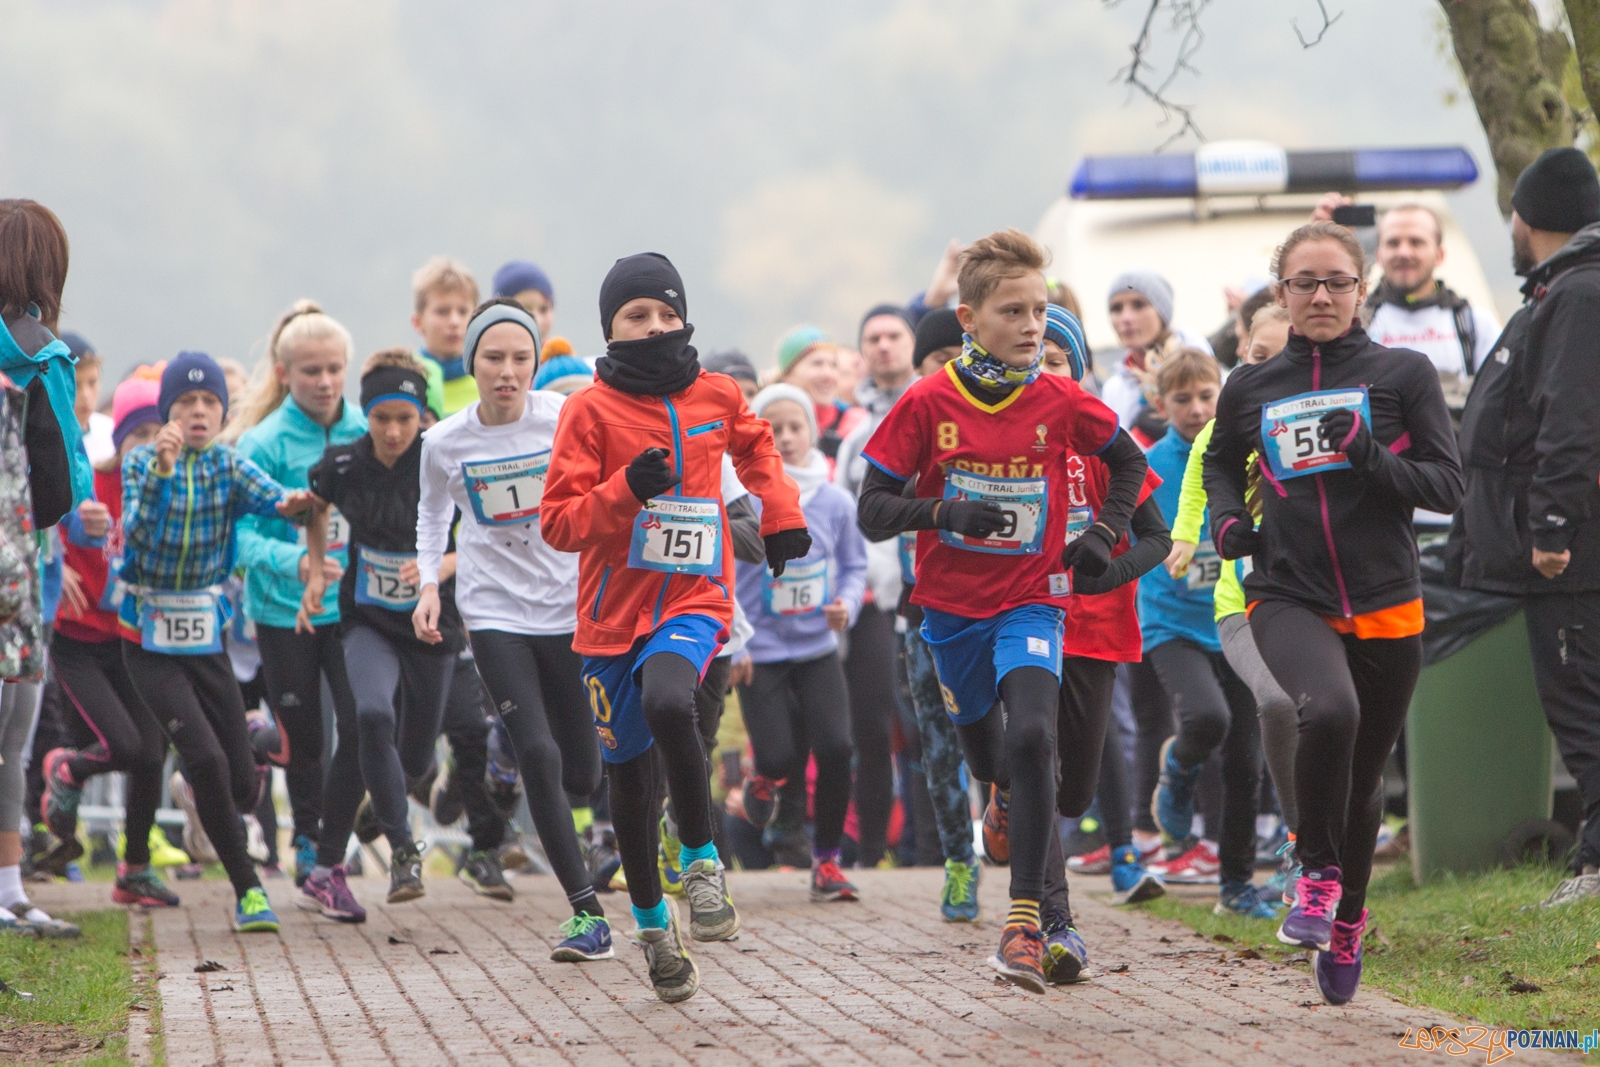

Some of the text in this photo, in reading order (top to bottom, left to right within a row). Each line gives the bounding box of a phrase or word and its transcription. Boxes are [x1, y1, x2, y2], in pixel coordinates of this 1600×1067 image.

[1329, 395, 1358, 405] Junior
[938, 421, 959, 451] 8
[523, 459, 545, 468] Junior
[506, 484, 520, 509] 1
[662, 528, 703, 559] 151
[375, 573, 417, 599] 123
[790, 584, 812, 607] 16
[165, 617, 205, 641] 155
